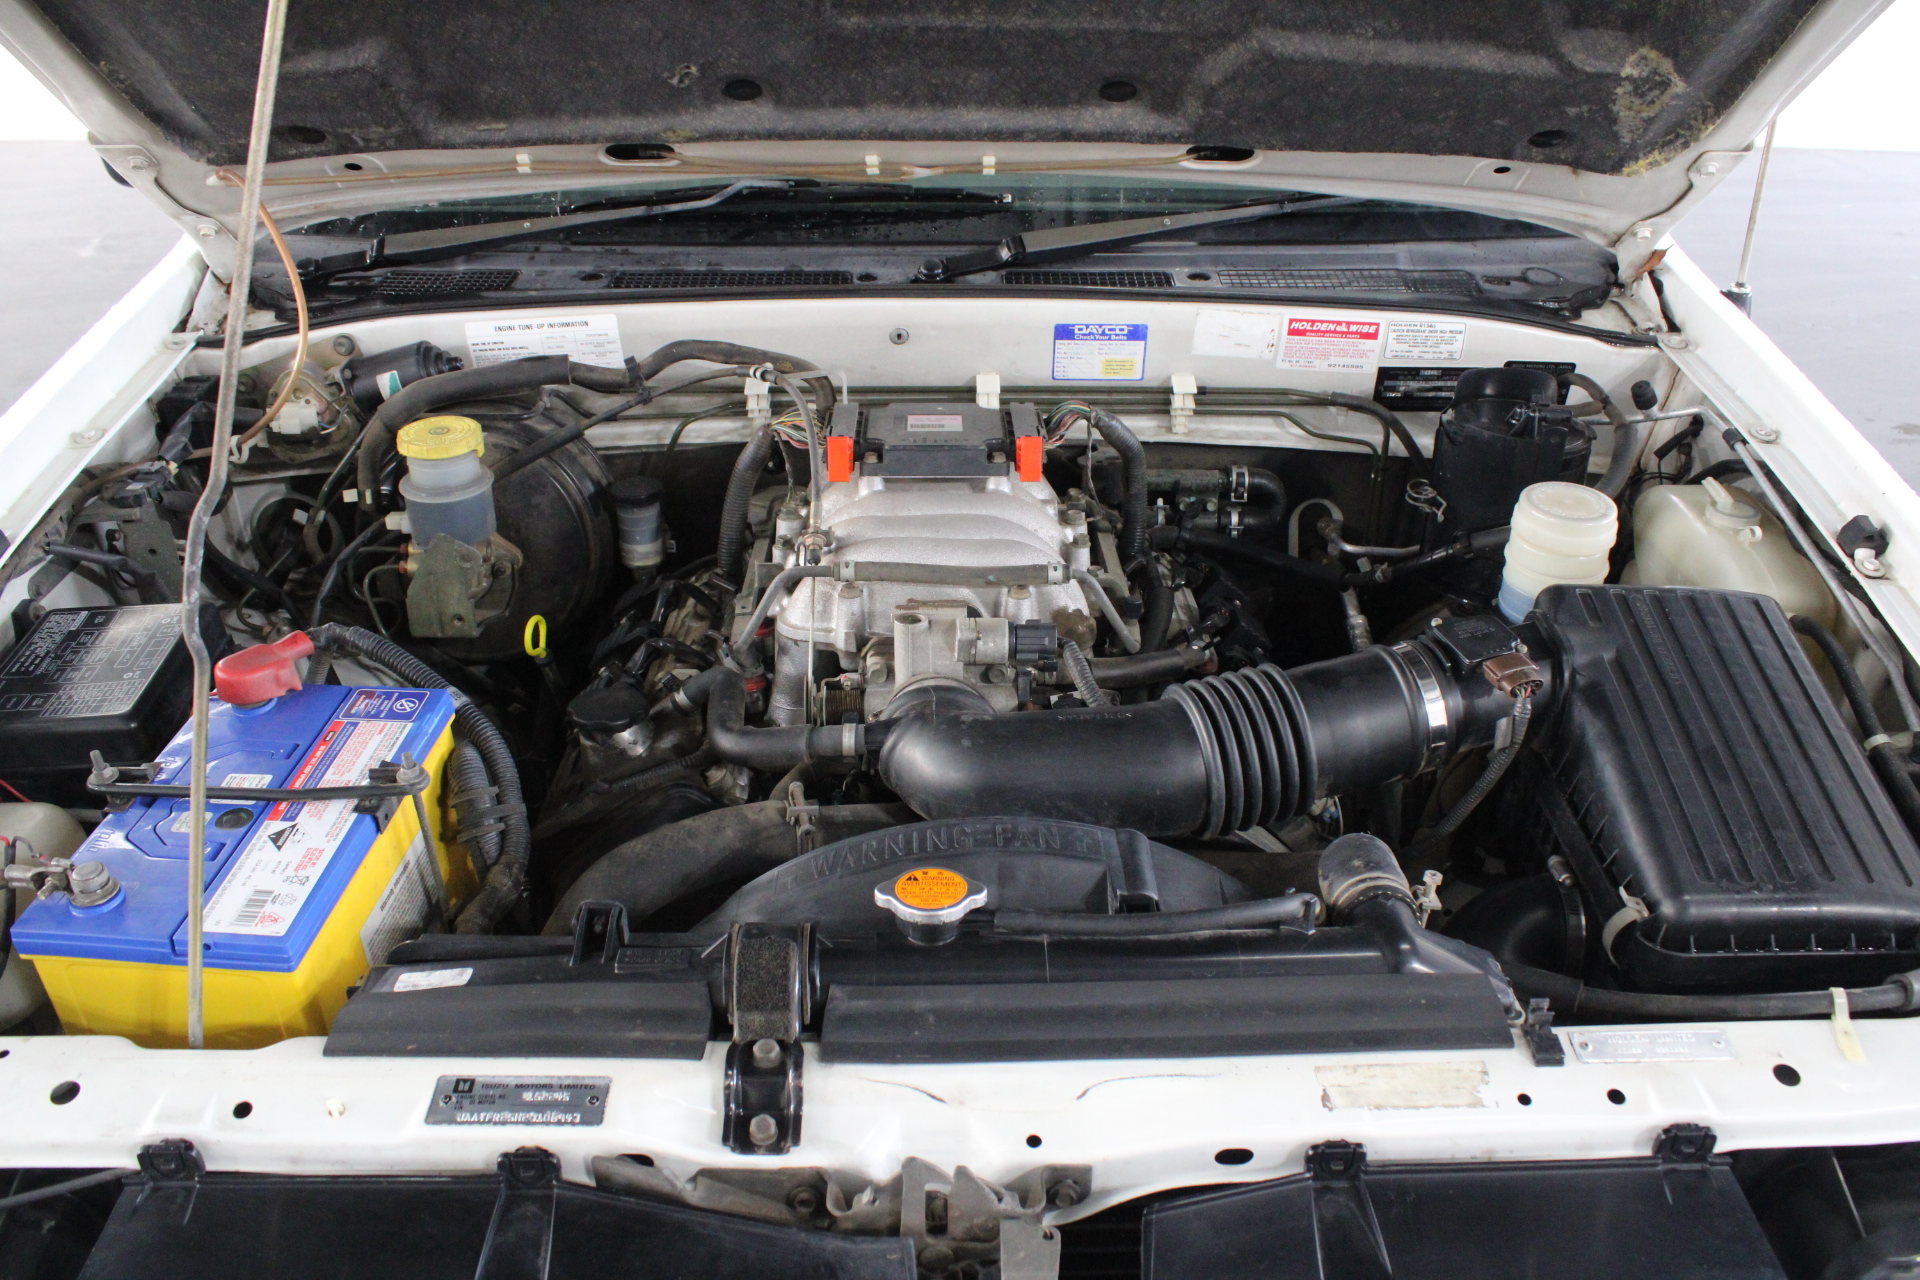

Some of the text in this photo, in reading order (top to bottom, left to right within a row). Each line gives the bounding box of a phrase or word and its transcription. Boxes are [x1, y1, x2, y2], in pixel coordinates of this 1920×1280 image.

[1075, 325, 1128, 334] DAYCO
[1290, 321, 1337, 331] HOLDEN
[1608, 1034, 1696, 1044] HOLDEN LIMITED
